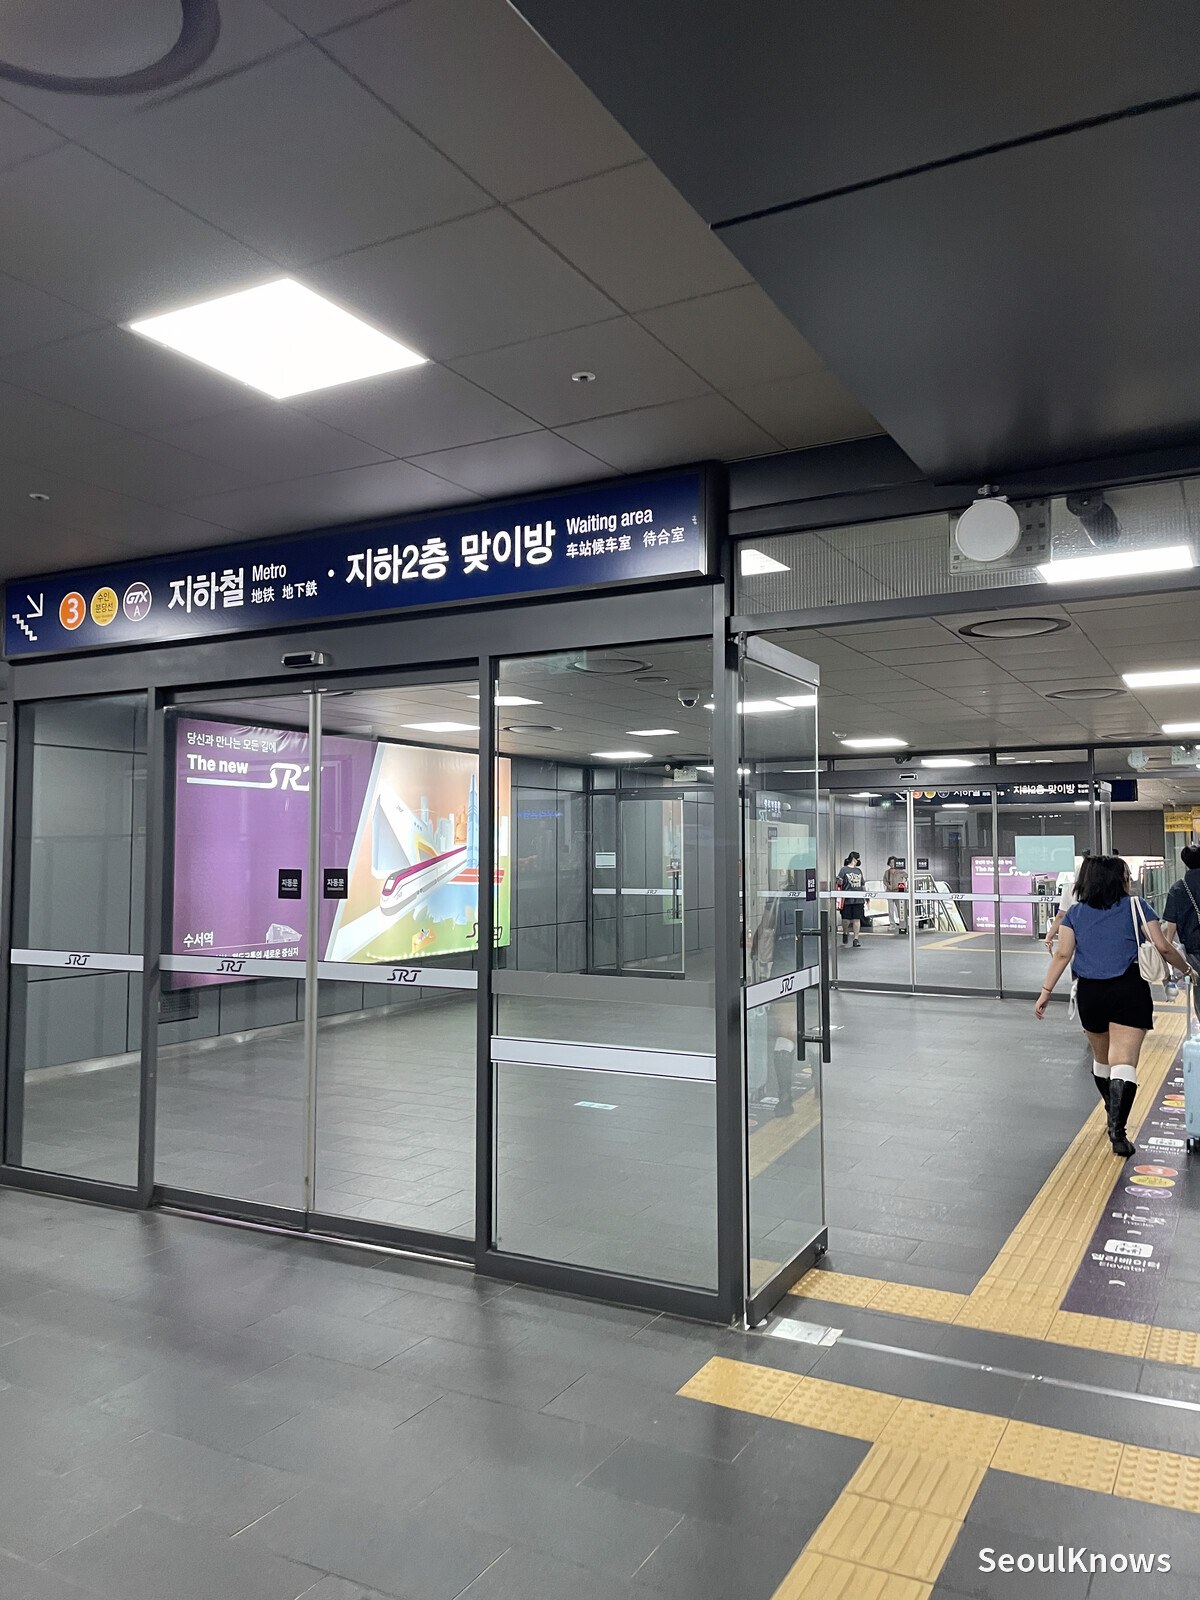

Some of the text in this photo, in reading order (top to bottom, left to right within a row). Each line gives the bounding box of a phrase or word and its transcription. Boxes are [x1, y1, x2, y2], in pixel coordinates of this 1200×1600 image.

[566, 509, 653, 535] Waiting area
[566, 526, 685, 559] 车站候车室 待合室
[345, 520, 556, 588] 지하2층 맞이방
[252, 563, 287, 582] Metro
[126, 590, 148, 605] GTX
[167, 567, 245, 613] 지하철
[251, 579, 318, 604] 地铁 地下鉄
[67, 597, 79, 624] 3
[96, 603, 114, 614] 분당선
[133, 605, 141, 617] A
[187, 732, 214, 747] 당신과
[216, 735, 241, 750] 만나는
[243, 739, 259, 751] 모든
[187, 753, 248, 774] The new
[1047, 783, 1075, 794] 맞이방
[183, 931, 214, 948] 수서역
[65, 954, 91, 966] SRT
[216, 960, 246, 972] SRT
[387, 969, 422, 983] SRT
[780, 976, 795, 994] SRT
[1099, 1261, 1145, 1273] Elevator
